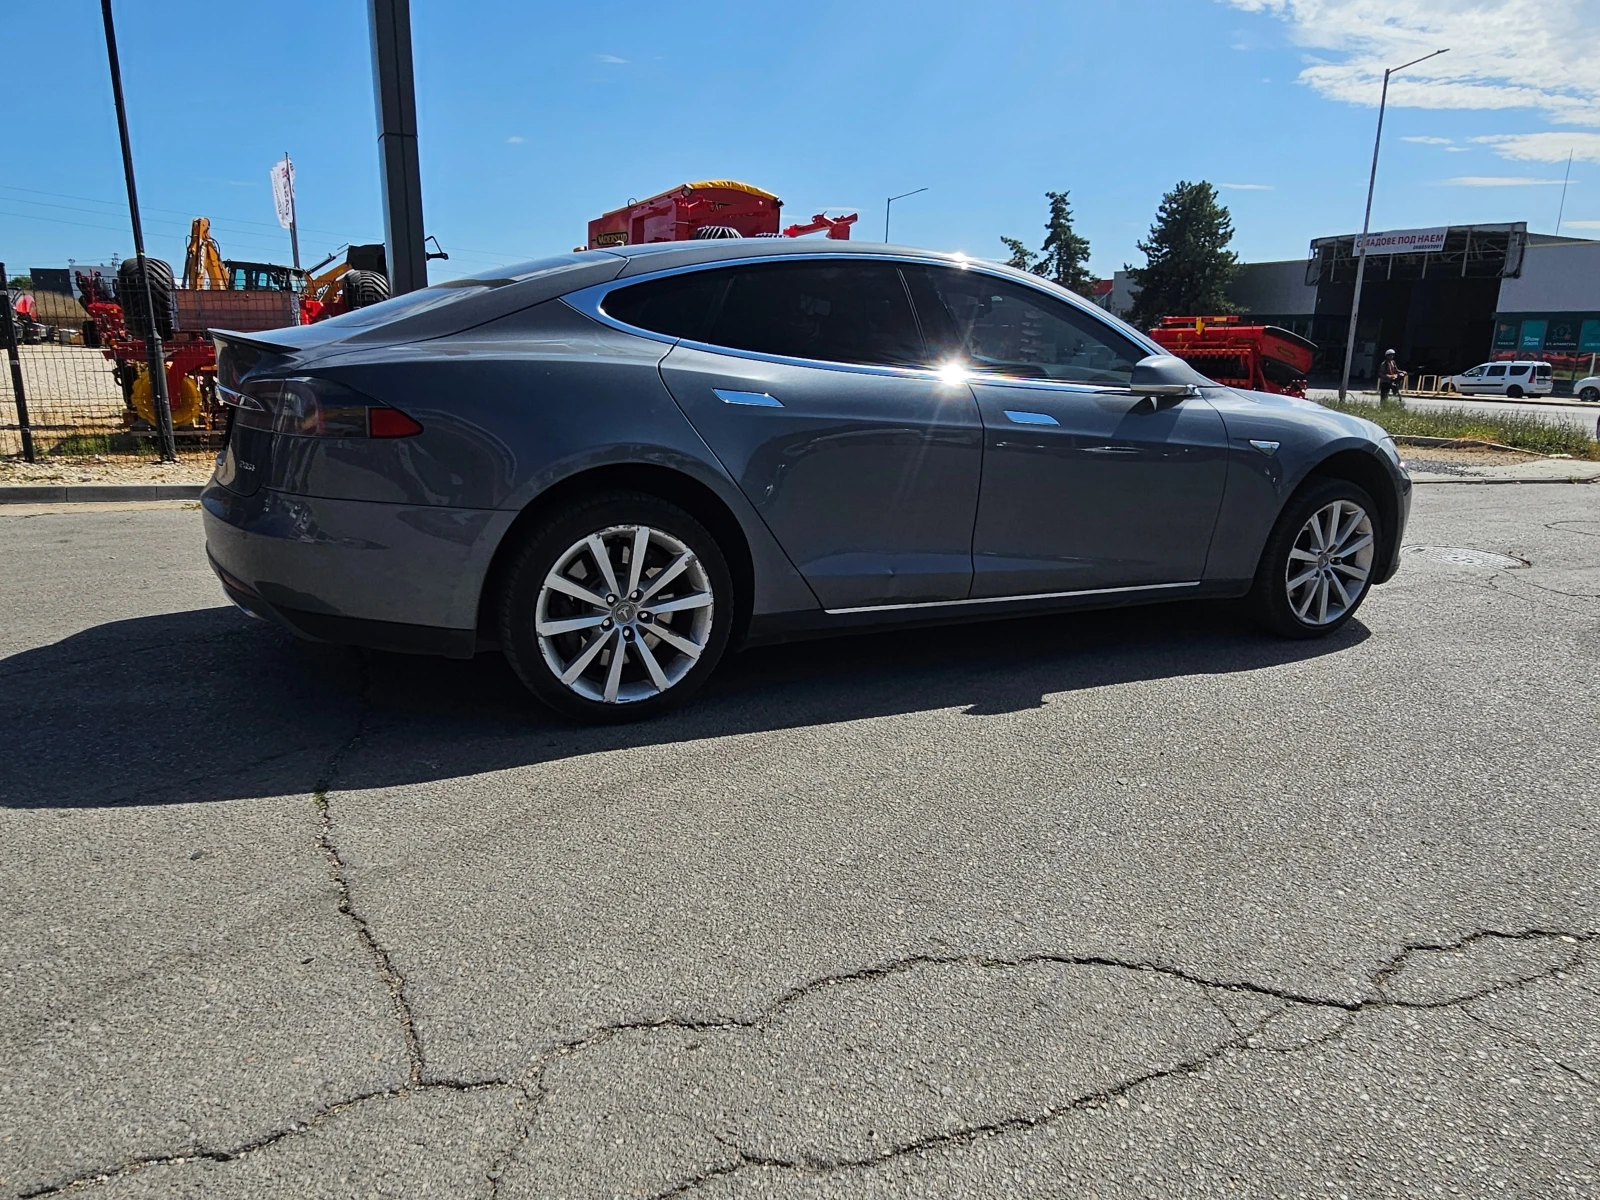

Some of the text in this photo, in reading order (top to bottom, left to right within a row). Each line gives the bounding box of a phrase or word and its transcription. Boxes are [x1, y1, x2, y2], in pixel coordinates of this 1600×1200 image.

[1356, 234, 1444, 248] СЛАДОВЕ ПОД НАЕМ
